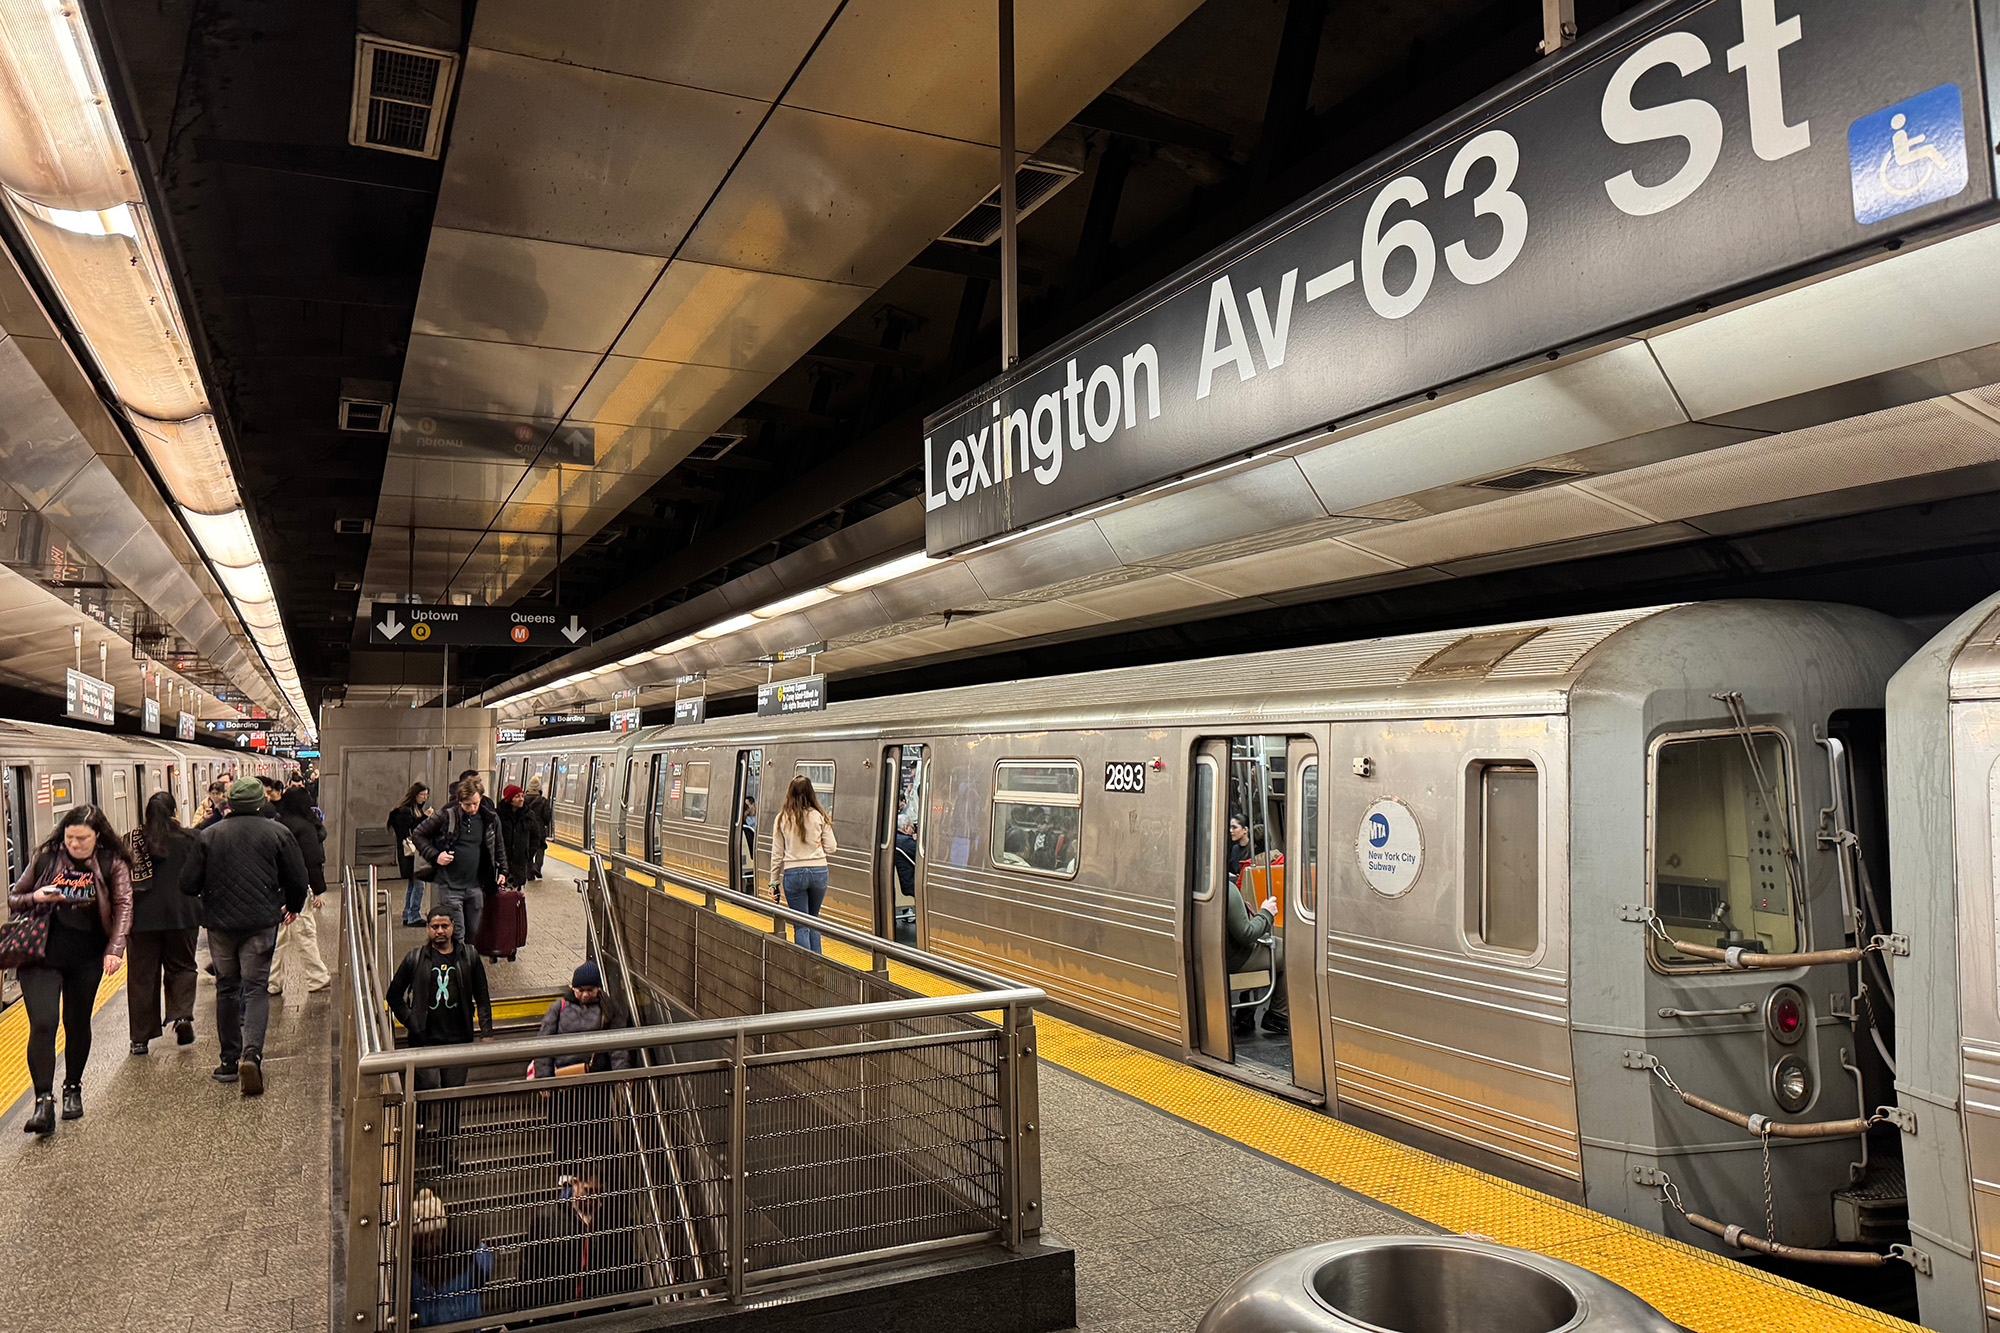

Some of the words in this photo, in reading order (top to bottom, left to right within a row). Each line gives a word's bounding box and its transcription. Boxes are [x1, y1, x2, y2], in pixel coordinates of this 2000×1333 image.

[924, 343, 1161, 513] Lexington
[1600, 0, 1811, 217] St
[411, 609, 459, 622] Uptown
[510, 612, 556, 624] Queens
[514, 628, 526, 639] M
[226, 721, 259, 729] Boarding
[557, 715, 585, 723] Boarding
[250, 732, 266, 740] Exit
[1105, 763, 1144, 791] 2893
[1369, 820, 1387, 840] MTA
[1368, 850, 1383, 860] New
[1384, 851, 1400, 861] York
[1401, 852, 1416, 864] City
[1368, 861, 1396, 874] Subway
